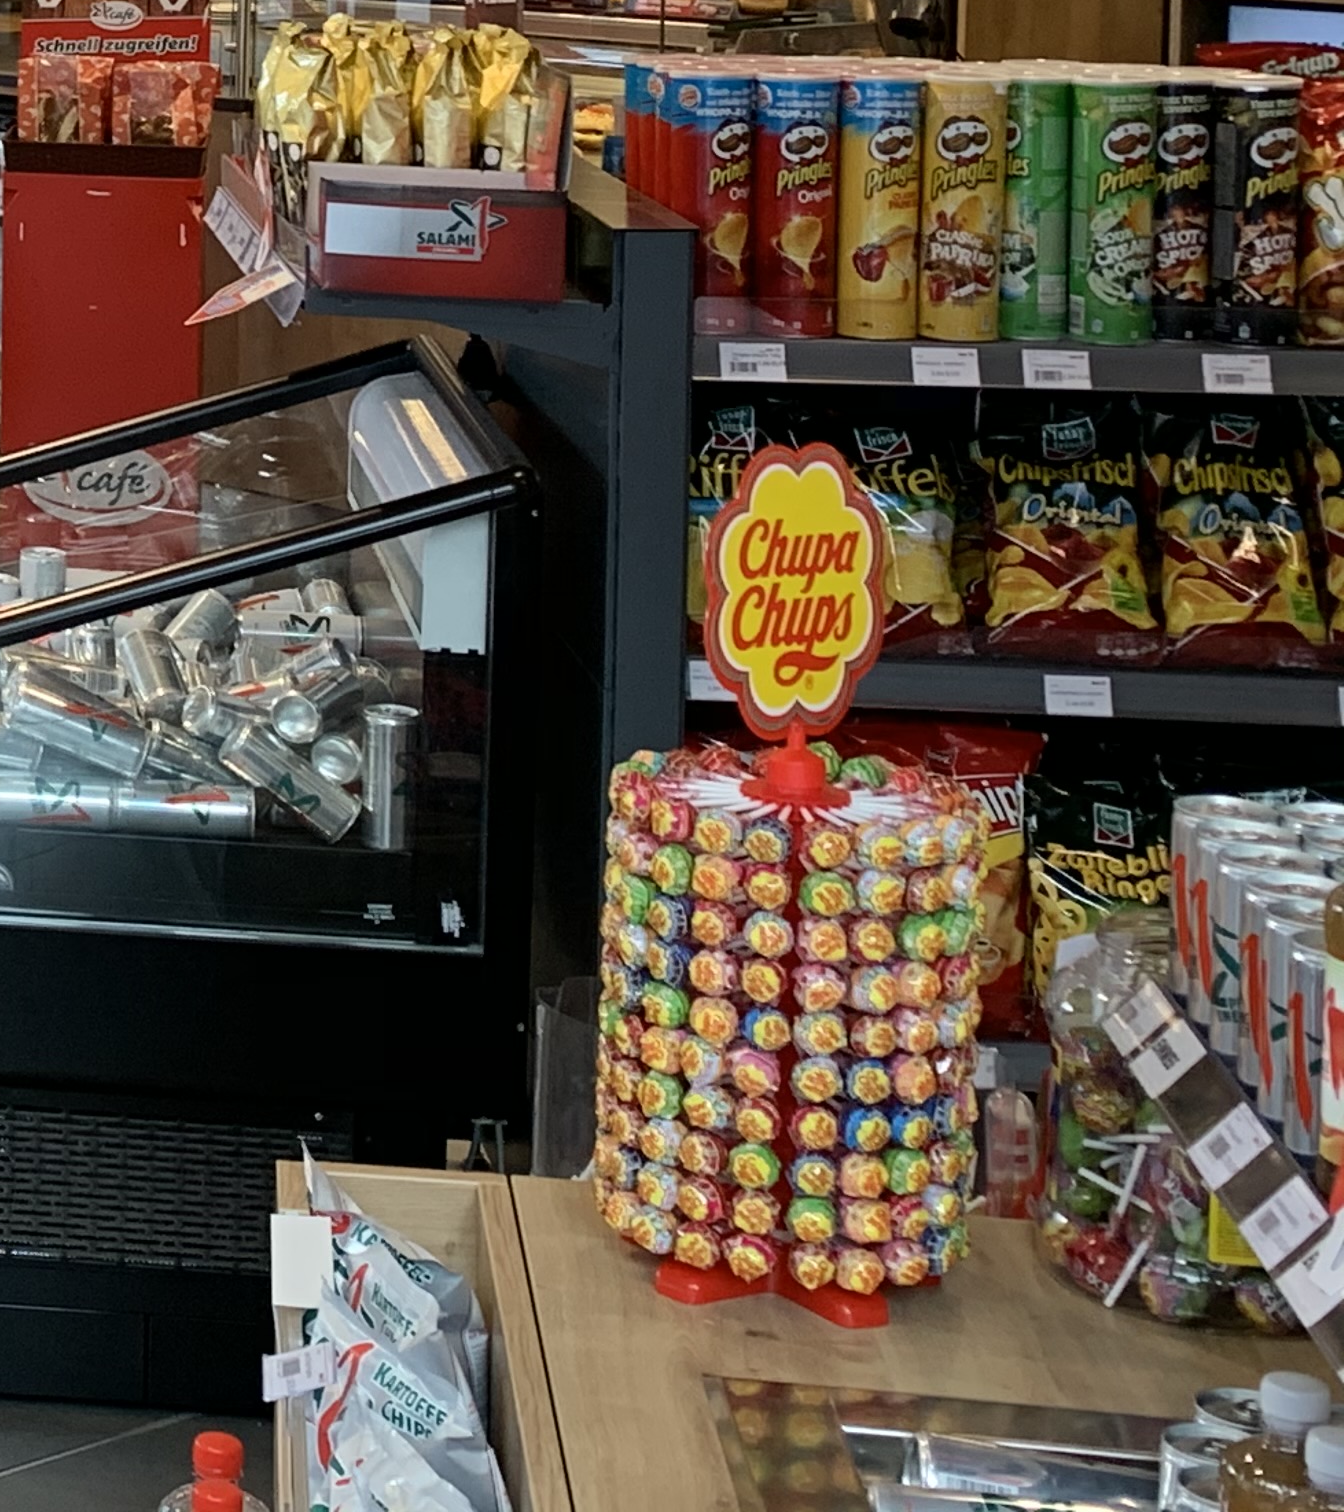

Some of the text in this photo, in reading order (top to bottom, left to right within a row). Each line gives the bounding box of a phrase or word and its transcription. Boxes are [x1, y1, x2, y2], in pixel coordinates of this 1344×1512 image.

[35, 35, 199, 56] Schnell zugreifen!
[776, 158, 833, 196] Pringles
[931, 157, 998, 200] Pringles
[416, 231, 476, 247] SALAMI
[77, 461, 150, 506] café
[738, 518, 861, 594] Chupa
[732, 582, 856, 686] Chups
